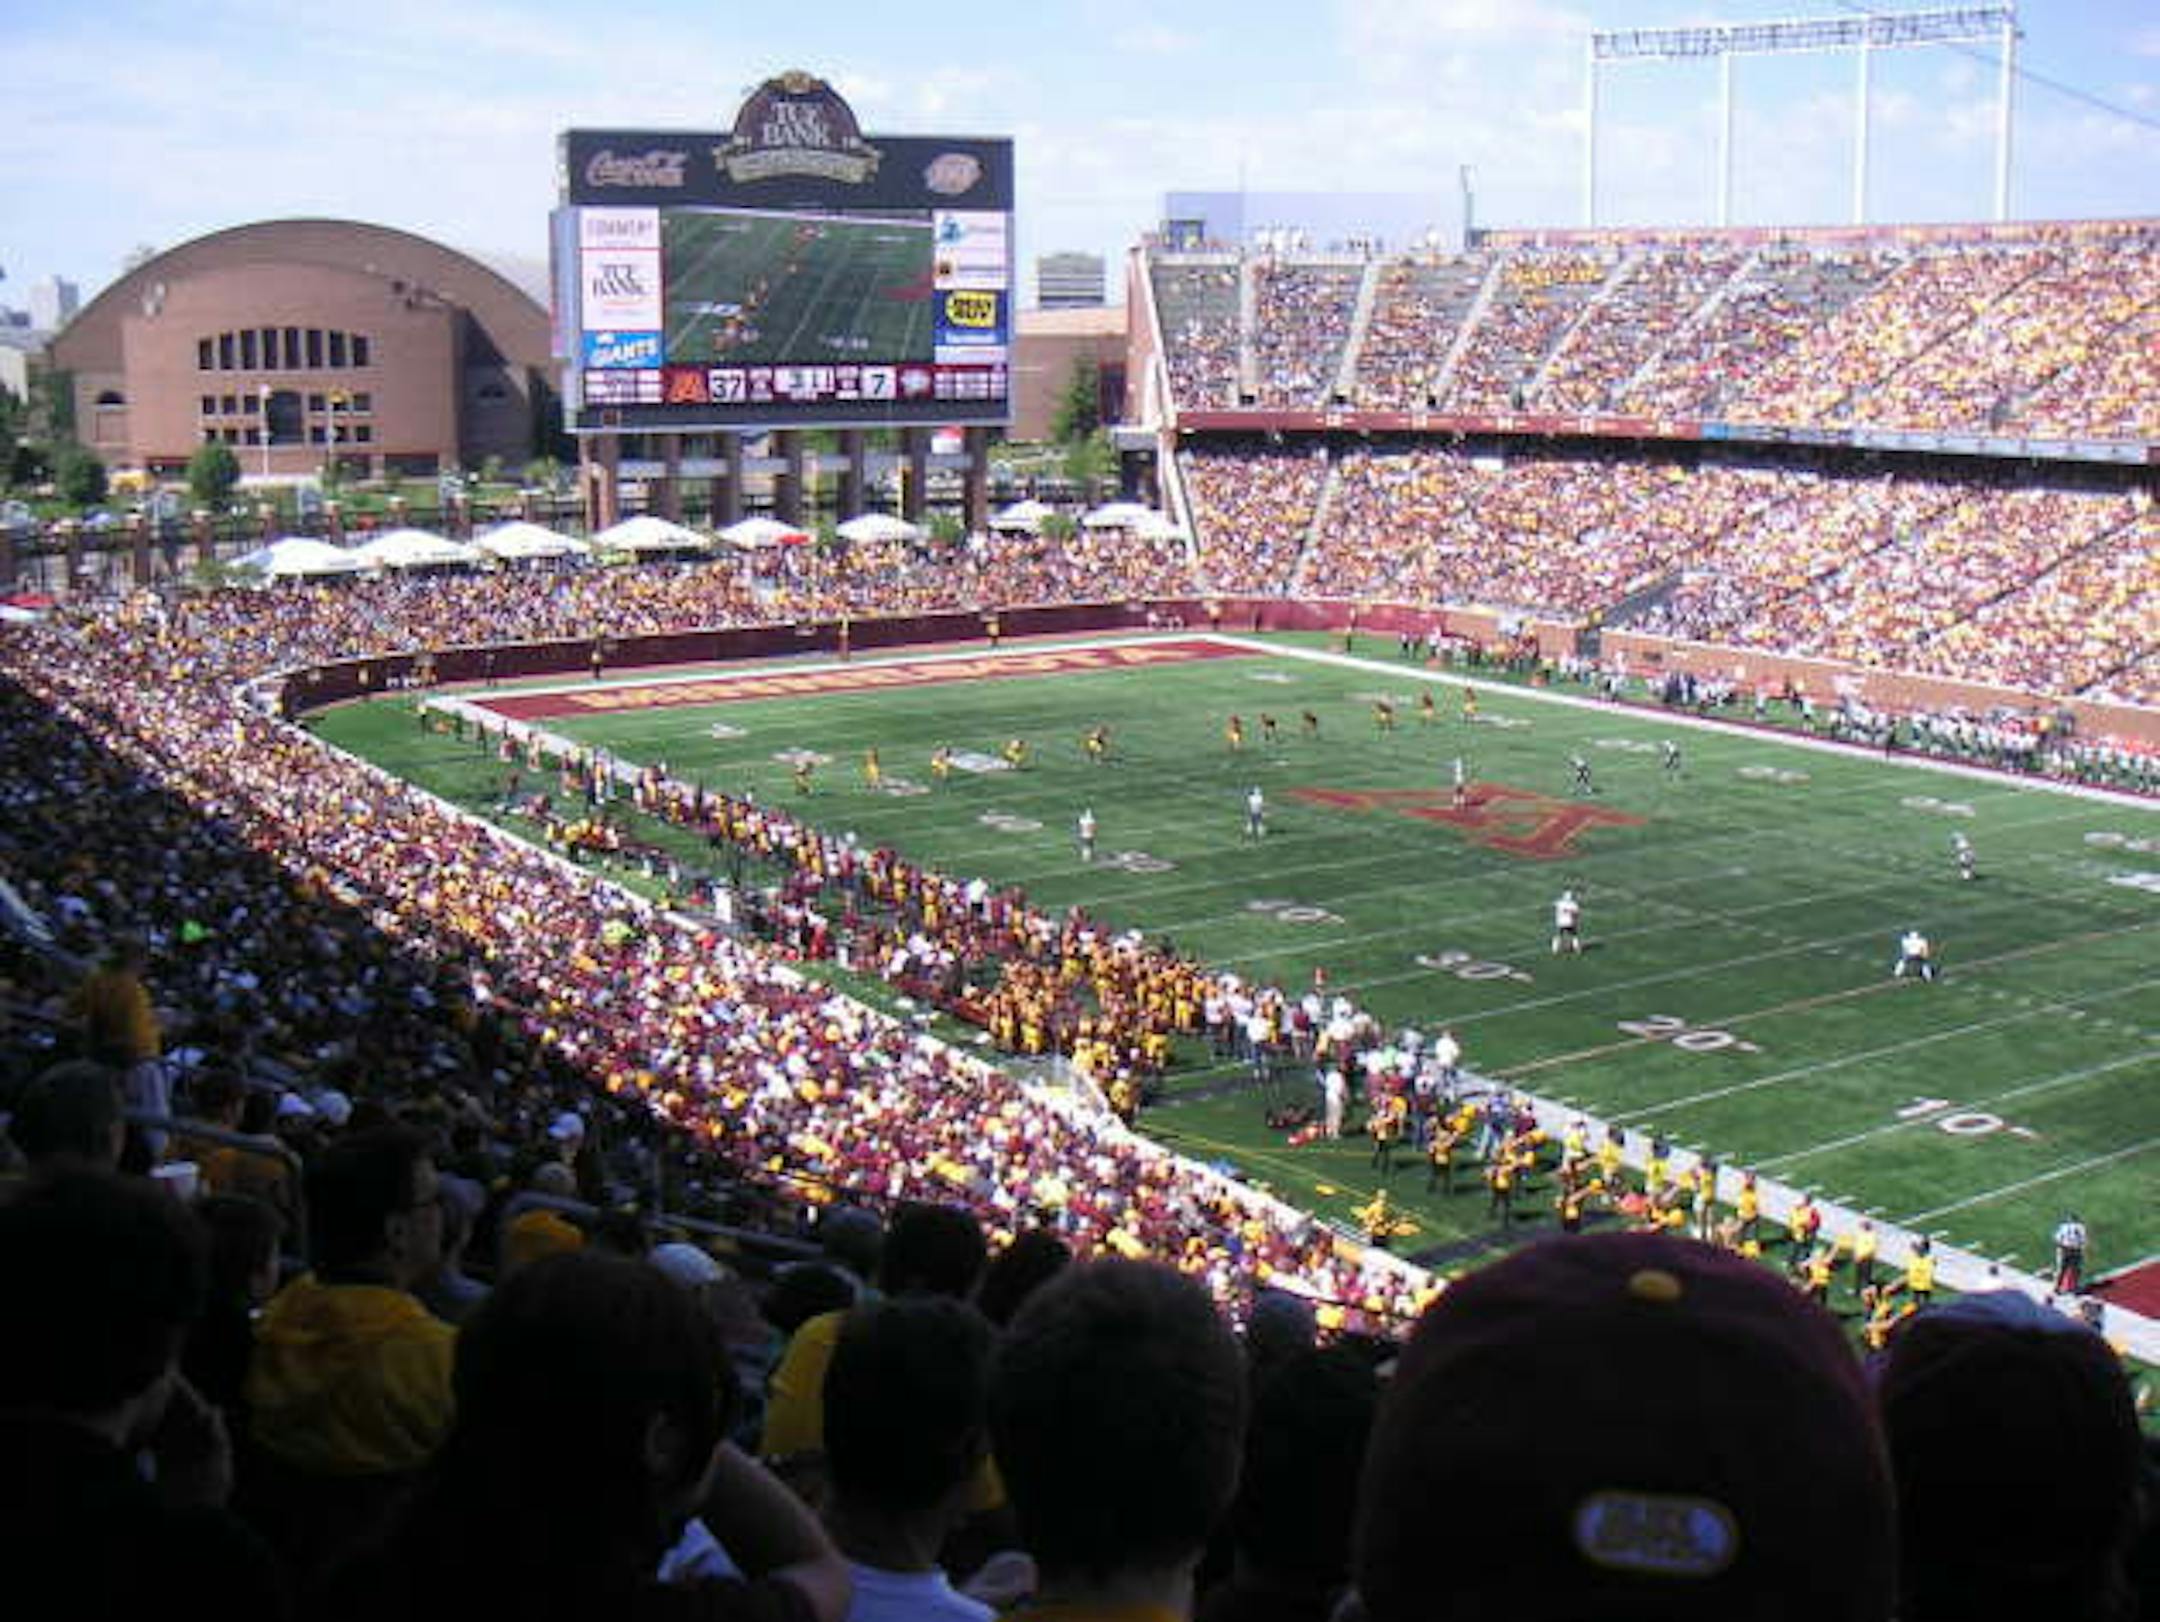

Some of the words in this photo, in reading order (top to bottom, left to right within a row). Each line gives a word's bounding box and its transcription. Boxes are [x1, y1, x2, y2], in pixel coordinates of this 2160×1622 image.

[763, 123, 829, 146] BANK
[711, 376, 741, 398] 37
[871, 374, 885, 396] 7
